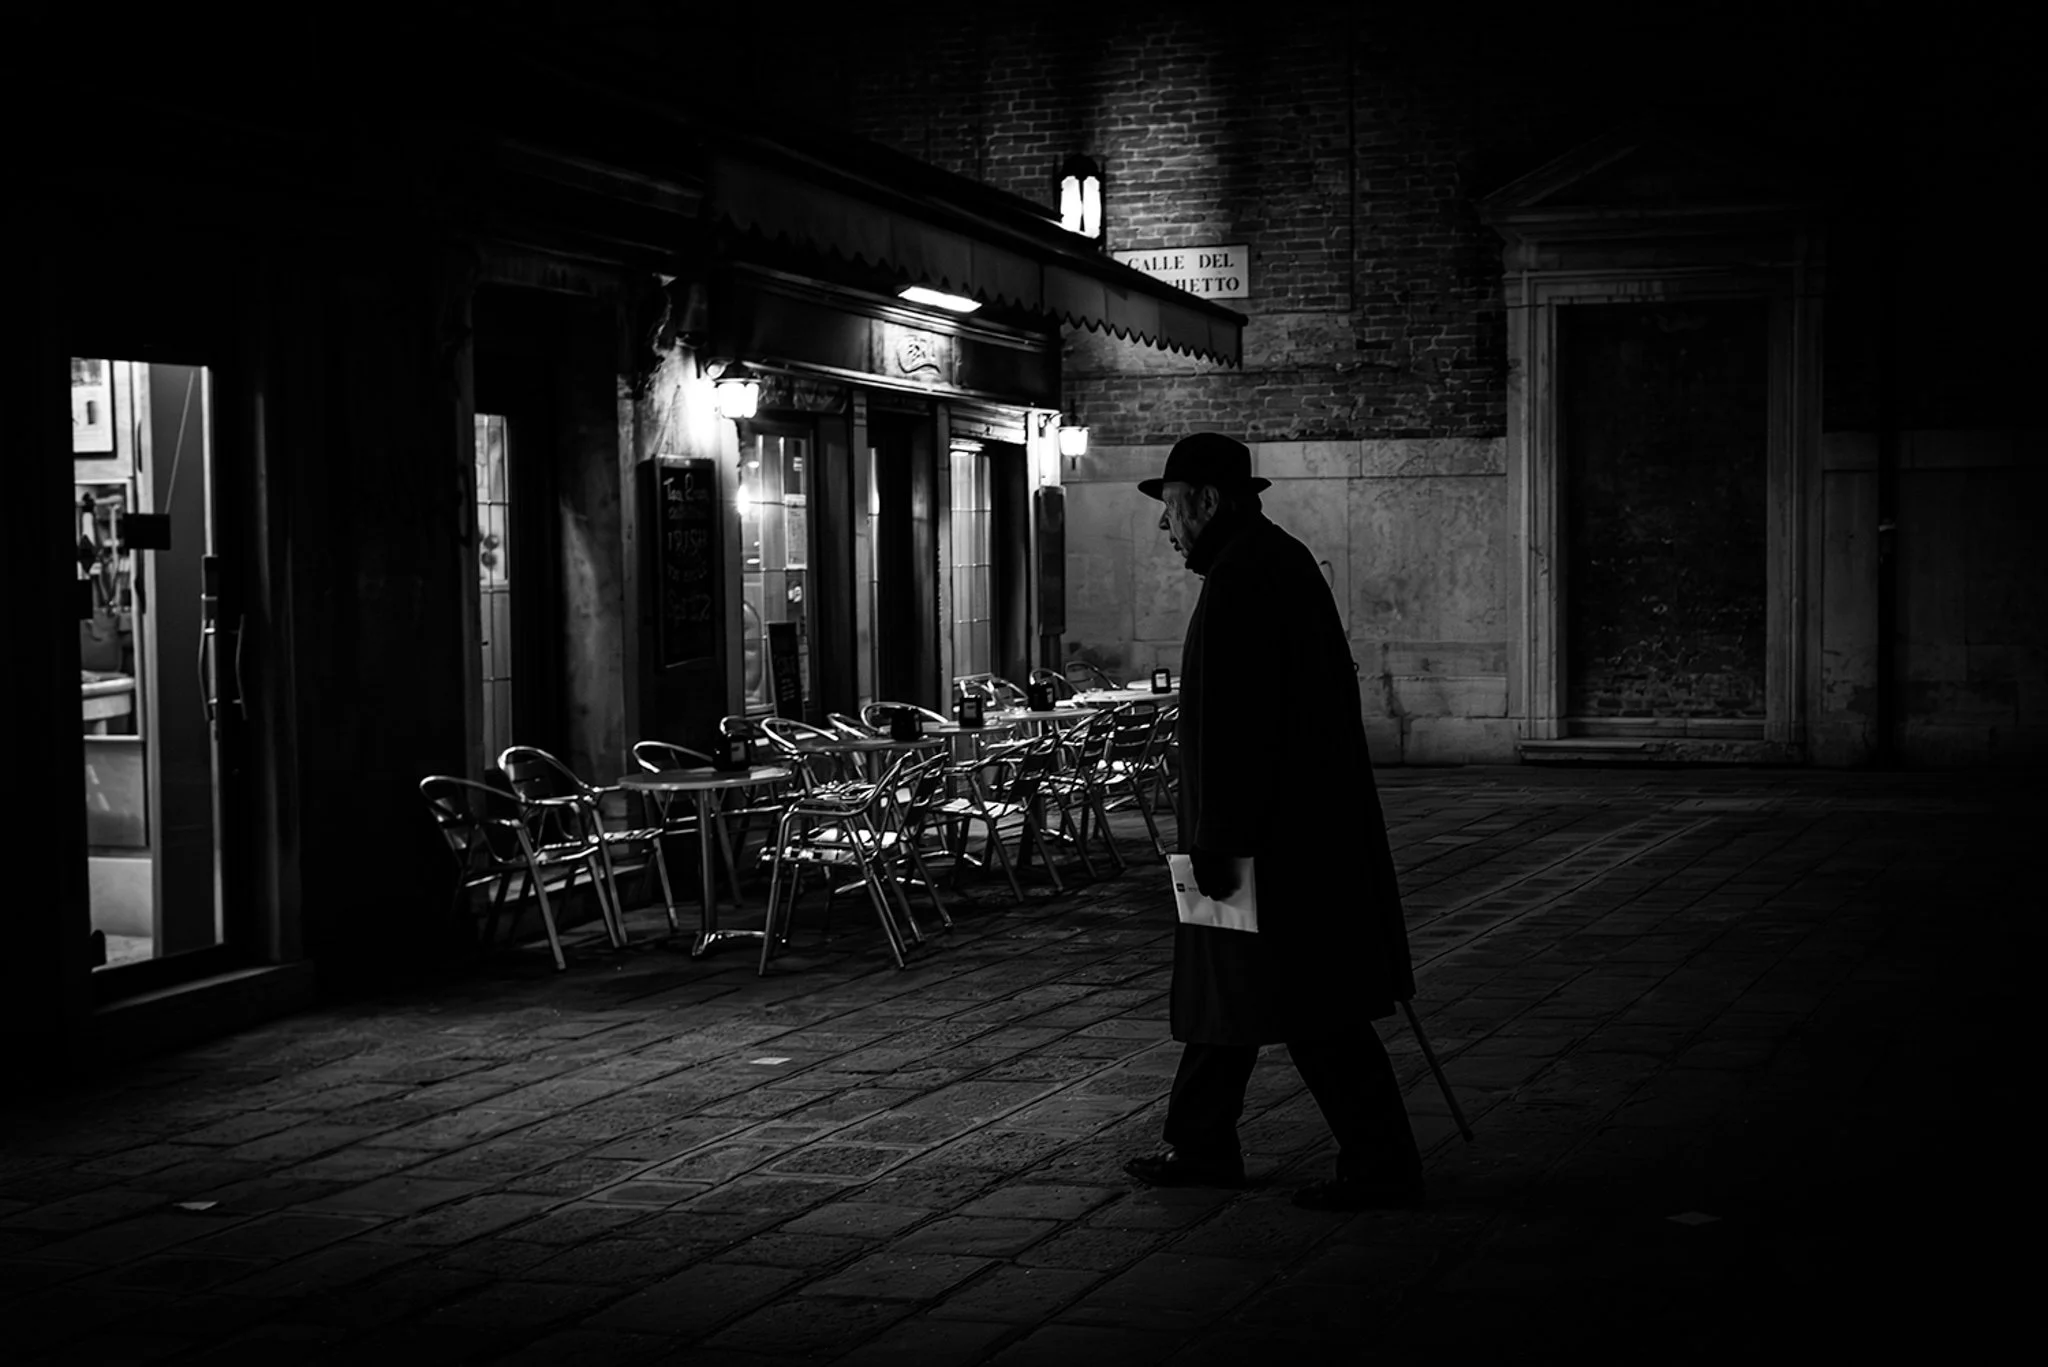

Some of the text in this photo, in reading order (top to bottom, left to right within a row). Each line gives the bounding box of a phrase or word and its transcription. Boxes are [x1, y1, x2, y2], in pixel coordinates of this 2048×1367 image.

[1128, 253, 1234, 271] CALLE DEL
[1167, 277, 1240, 293] HETTO
